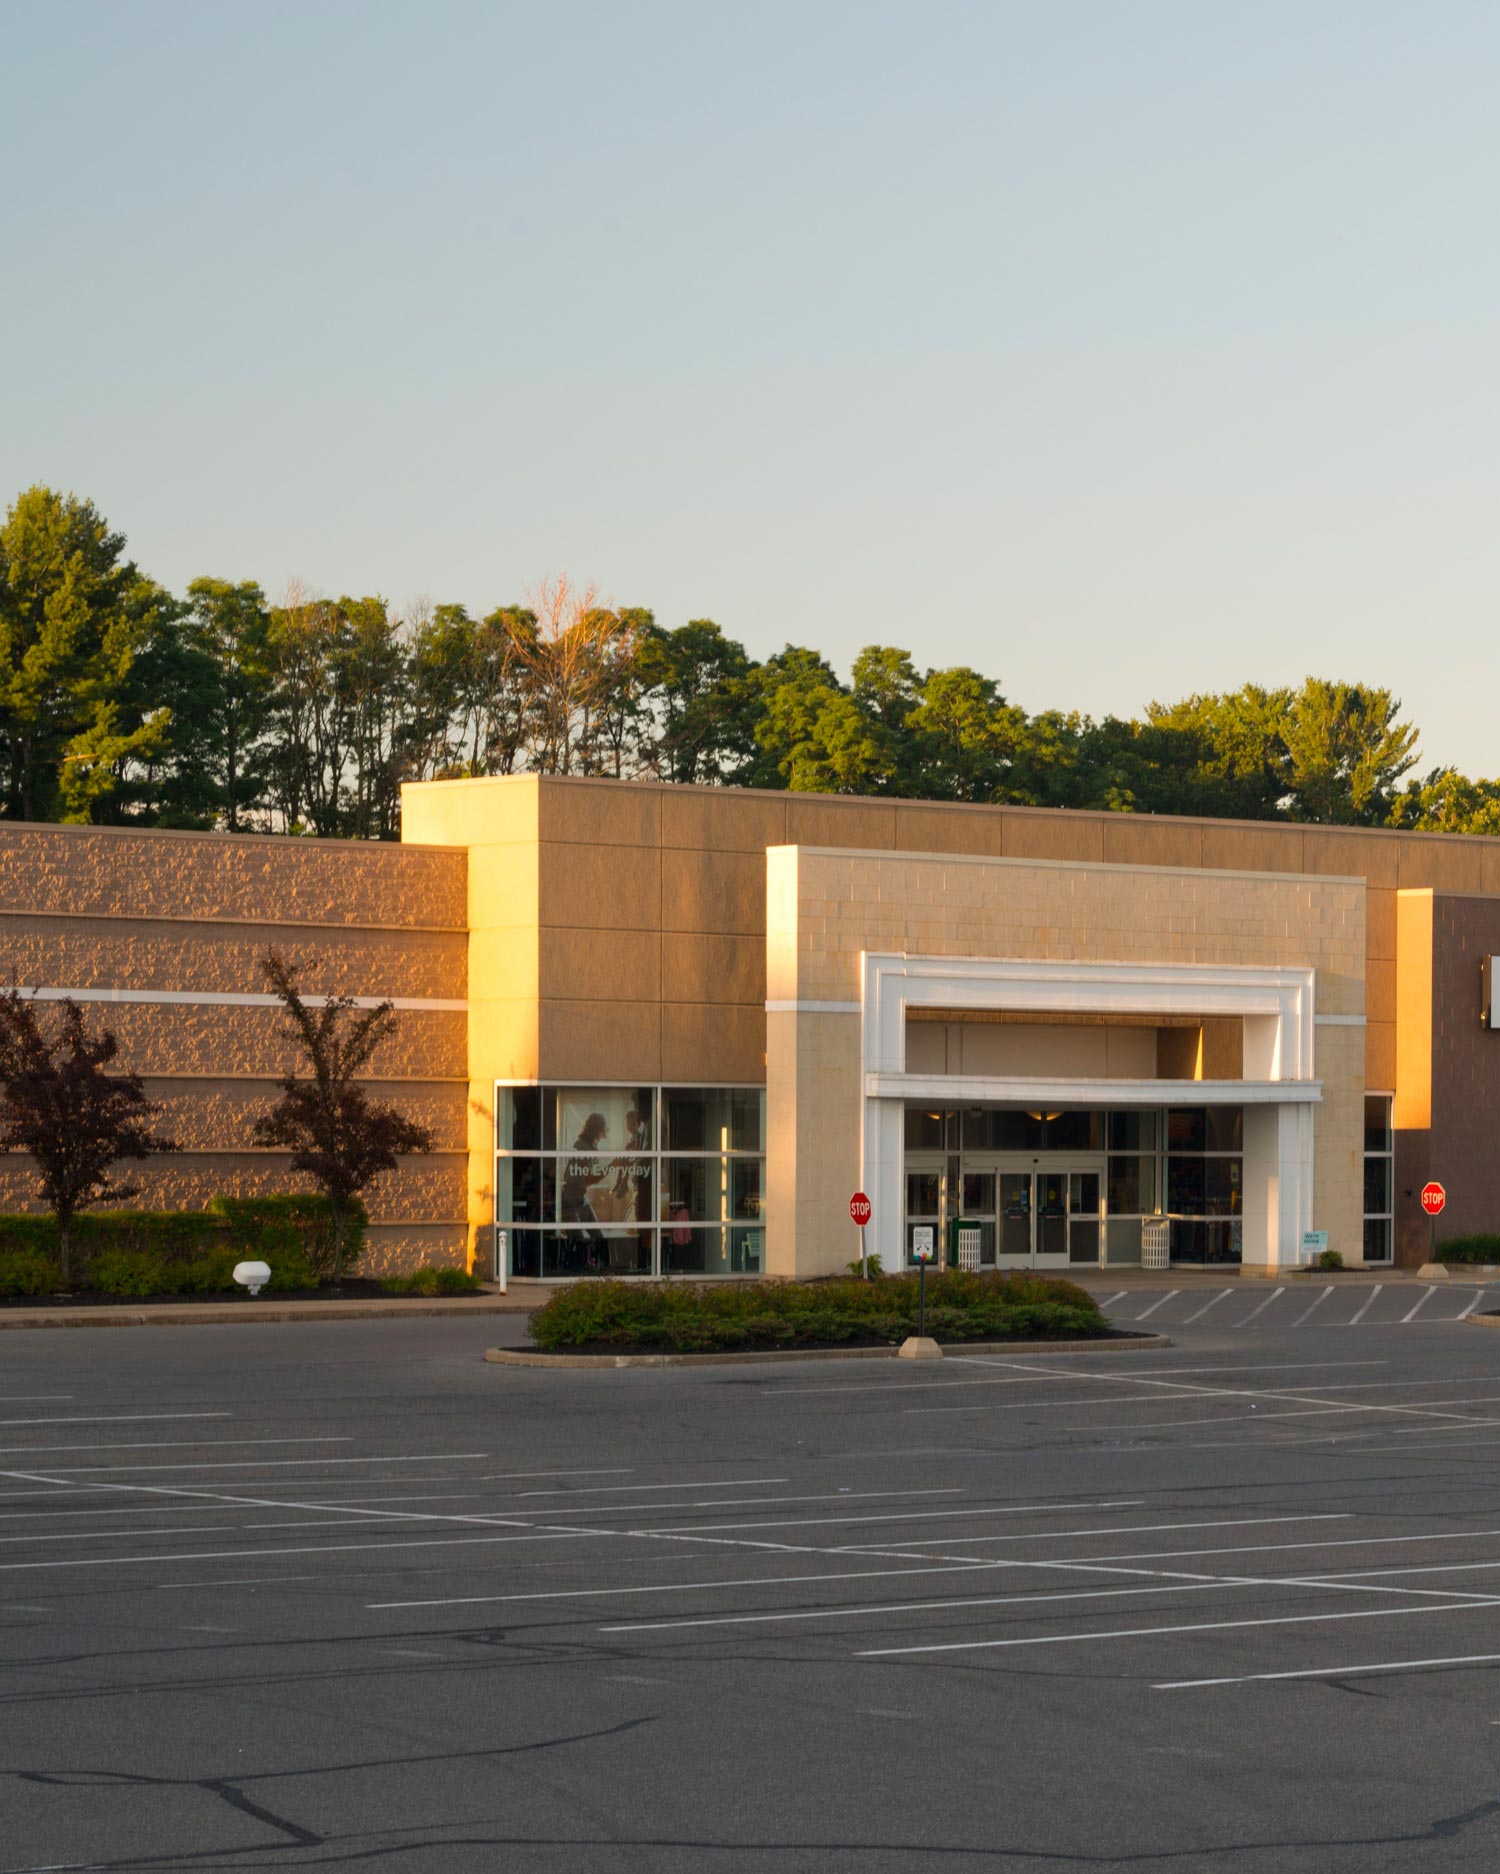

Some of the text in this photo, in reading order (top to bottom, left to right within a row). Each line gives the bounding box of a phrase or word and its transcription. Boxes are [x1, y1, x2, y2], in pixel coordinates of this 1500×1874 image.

[569, 1162, 651, 1179] the Everyday
[1423, 1192, 1443, 1205] STOP
[851, 1202, 870, 1216] STOP
